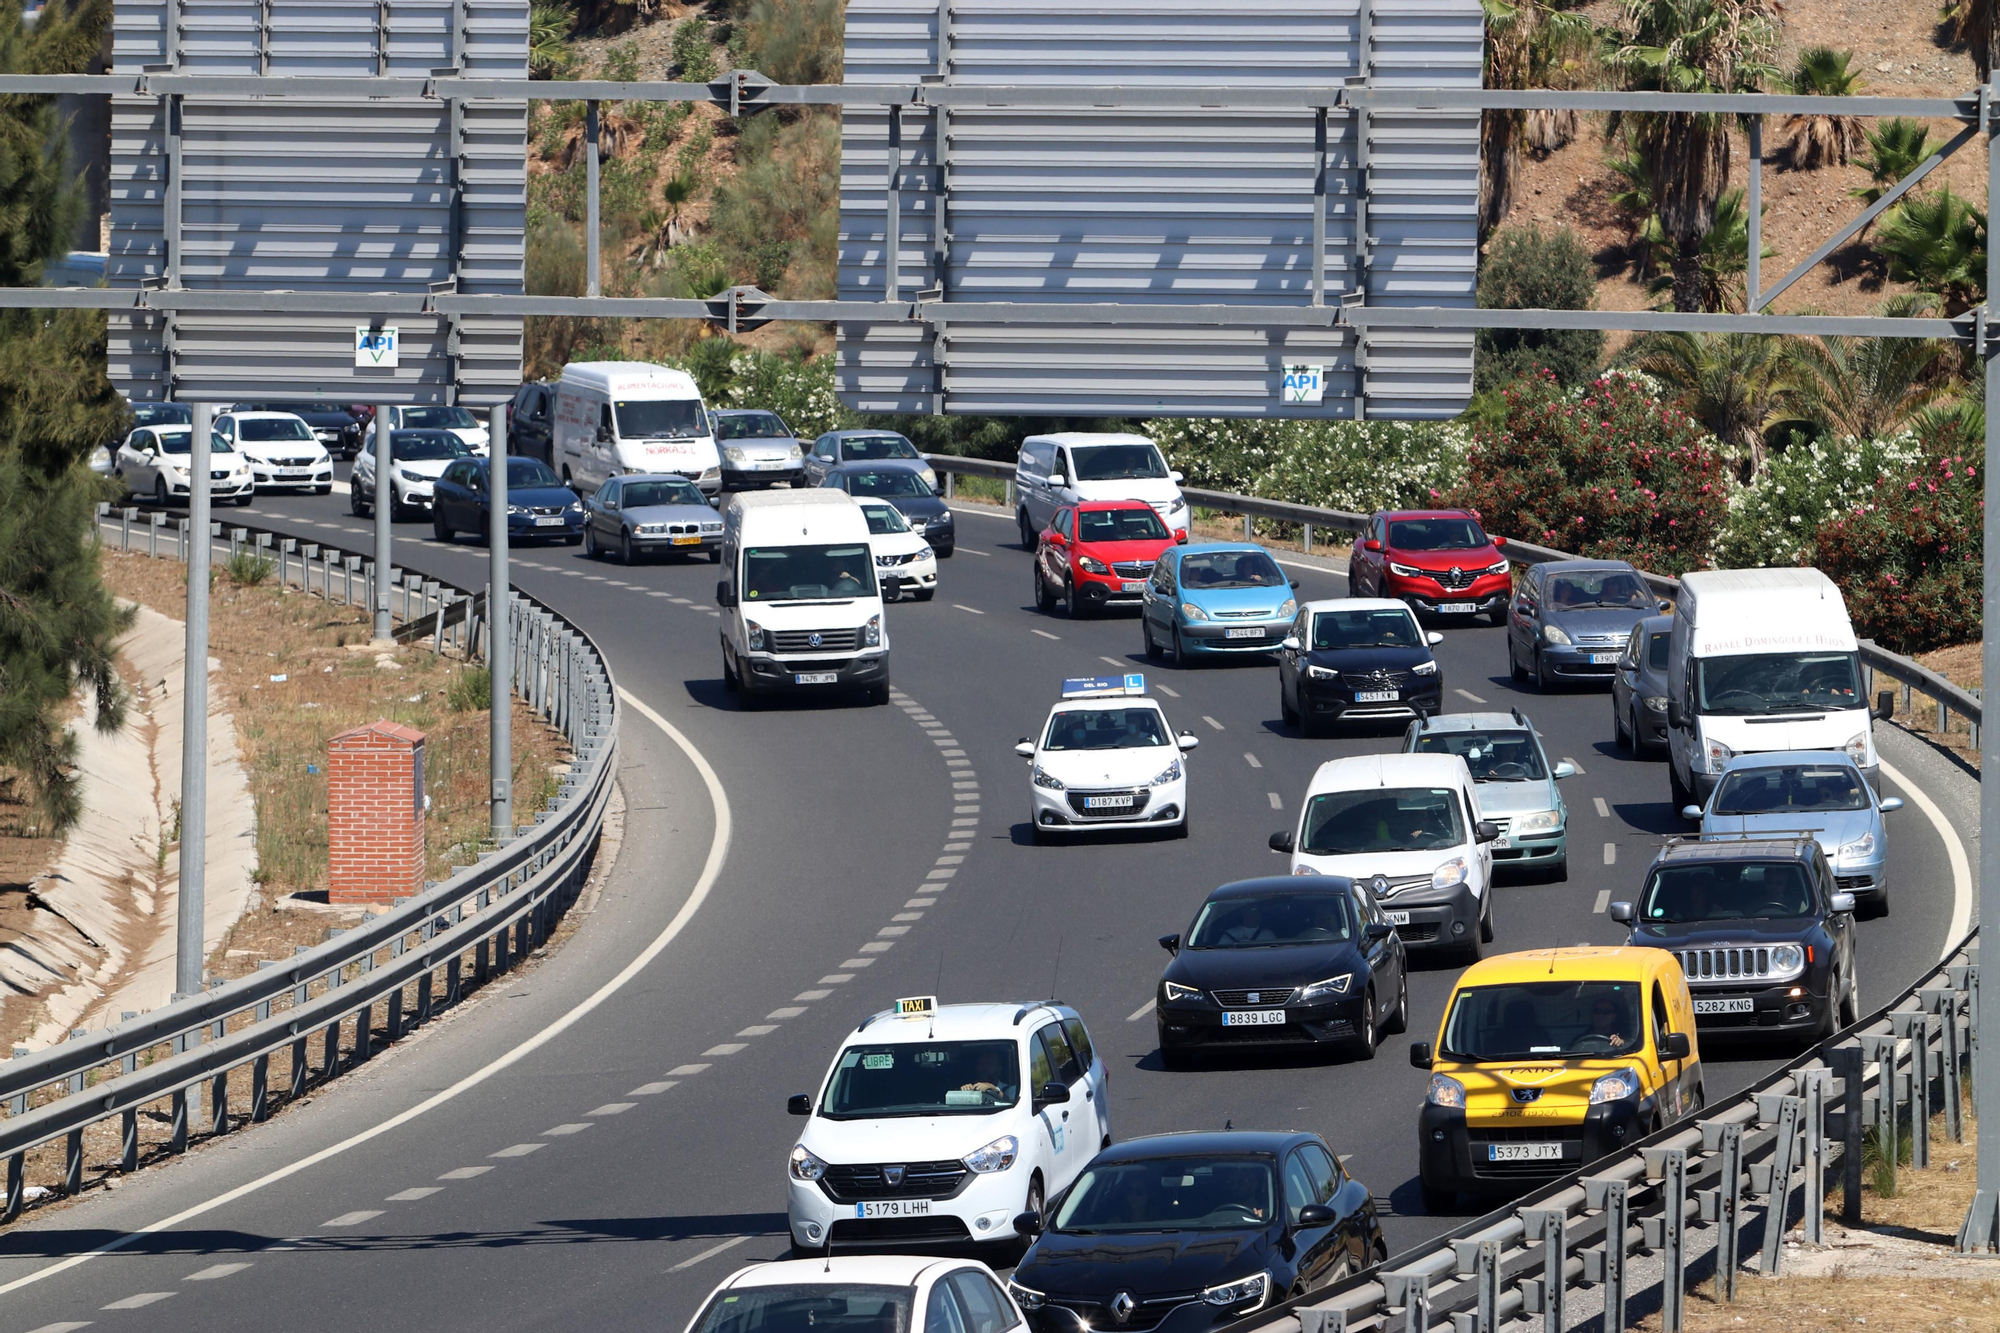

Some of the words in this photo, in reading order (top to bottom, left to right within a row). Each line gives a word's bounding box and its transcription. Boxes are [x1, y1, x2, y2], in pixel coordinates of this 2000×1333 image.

[358, 336, 393, 350] API
[1282, 374, 1318, 390] API
[1704, 641, 1742, 653] RAFAEL
[1595, 655, 1614, 663] 6390
[1129, 677, 1139, 687] L
[1360, 692, 1380, 701] 5451
[1091, 797, 1113, 807] 0187
[1115, 796, 1132, 805] KVP
[1490, 838, 1507, 848] CPR
[903, 999, 924, 1013] TAXI
[1697, 1001, 1726, 1013] 5282
[1729, 1000, 1751, 1011] KNG
[1229, 1013, 1258, 1024] 8839
[1261, 1012, 1283, 1024] LGC
[865, 1054, 891, 1067] LIBRE
[1509, 1067, 1556, 1075] FAIN
[1497, 1146, 1530, 1158] 5373
[1534, 1145, 1558, 1158] JTX
[865, 1202, 899, 1215] 5179
[903, 1201, 929, 1215] LHH
